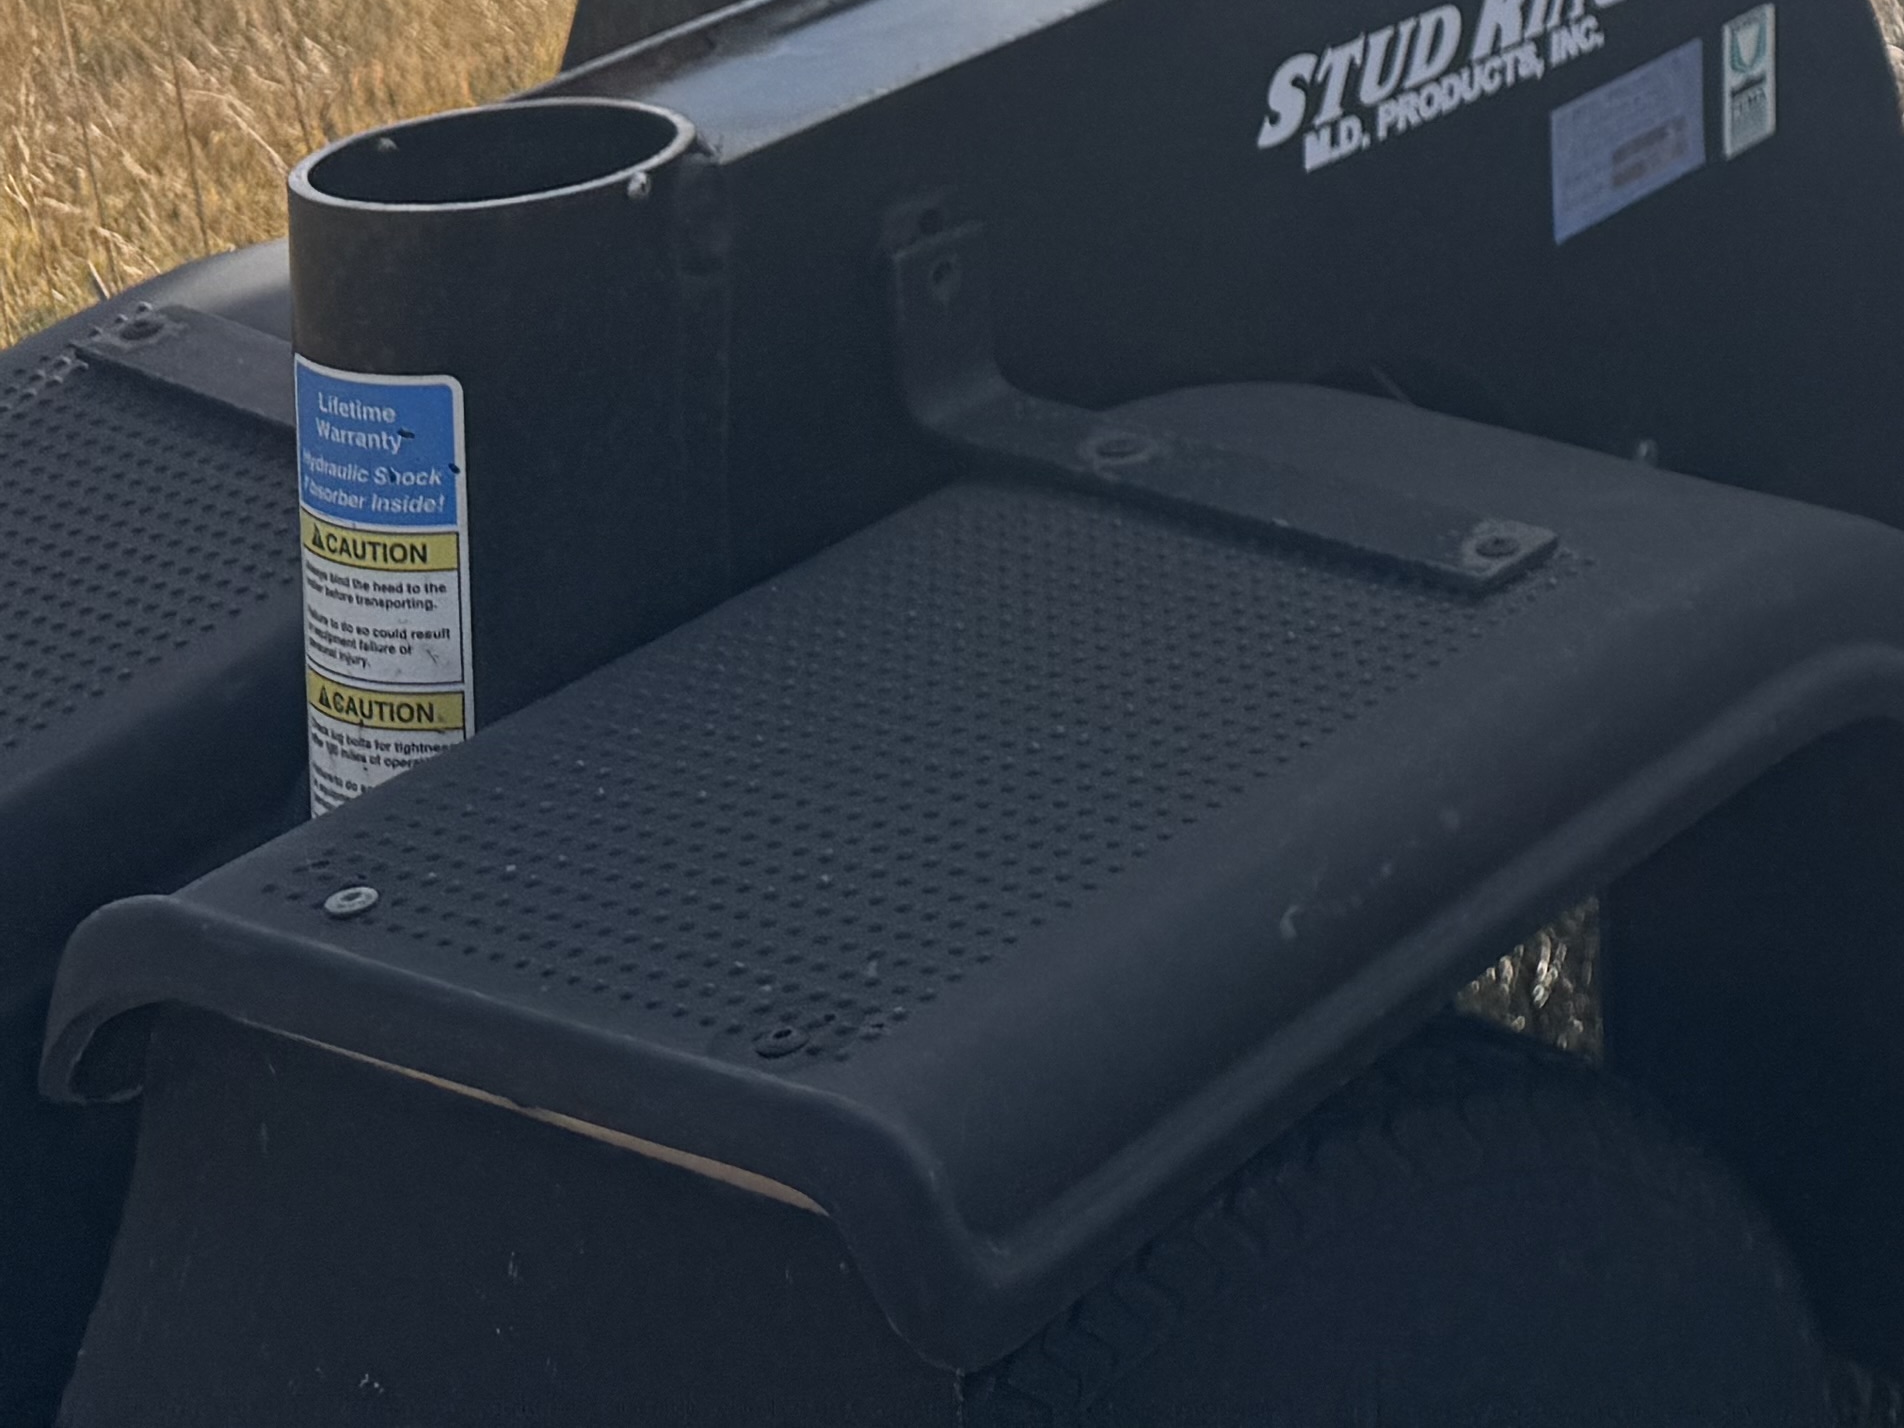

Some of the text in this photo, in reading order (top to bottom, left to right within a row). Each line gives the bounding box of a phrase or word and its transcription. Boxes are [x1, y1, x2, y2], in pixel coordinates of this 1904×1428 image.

[1256, 3, 1463, 149] STUD
[318, 392, 397, 424] Lifetime
[315, 417, 402, 455] Warranty
[326, 533, 428, 565] CAUTION
[352, 577, 370, 592] the
[373, 580, 403, 594] head
[407, 583, 421, 594] to
[424, 583, 447, 594] the
[372, 627, 407, 640] could
[410, 628, 451, 641] result
[332, 692, 435, 724] CAUTION
[374, 739, 391, 752] for
